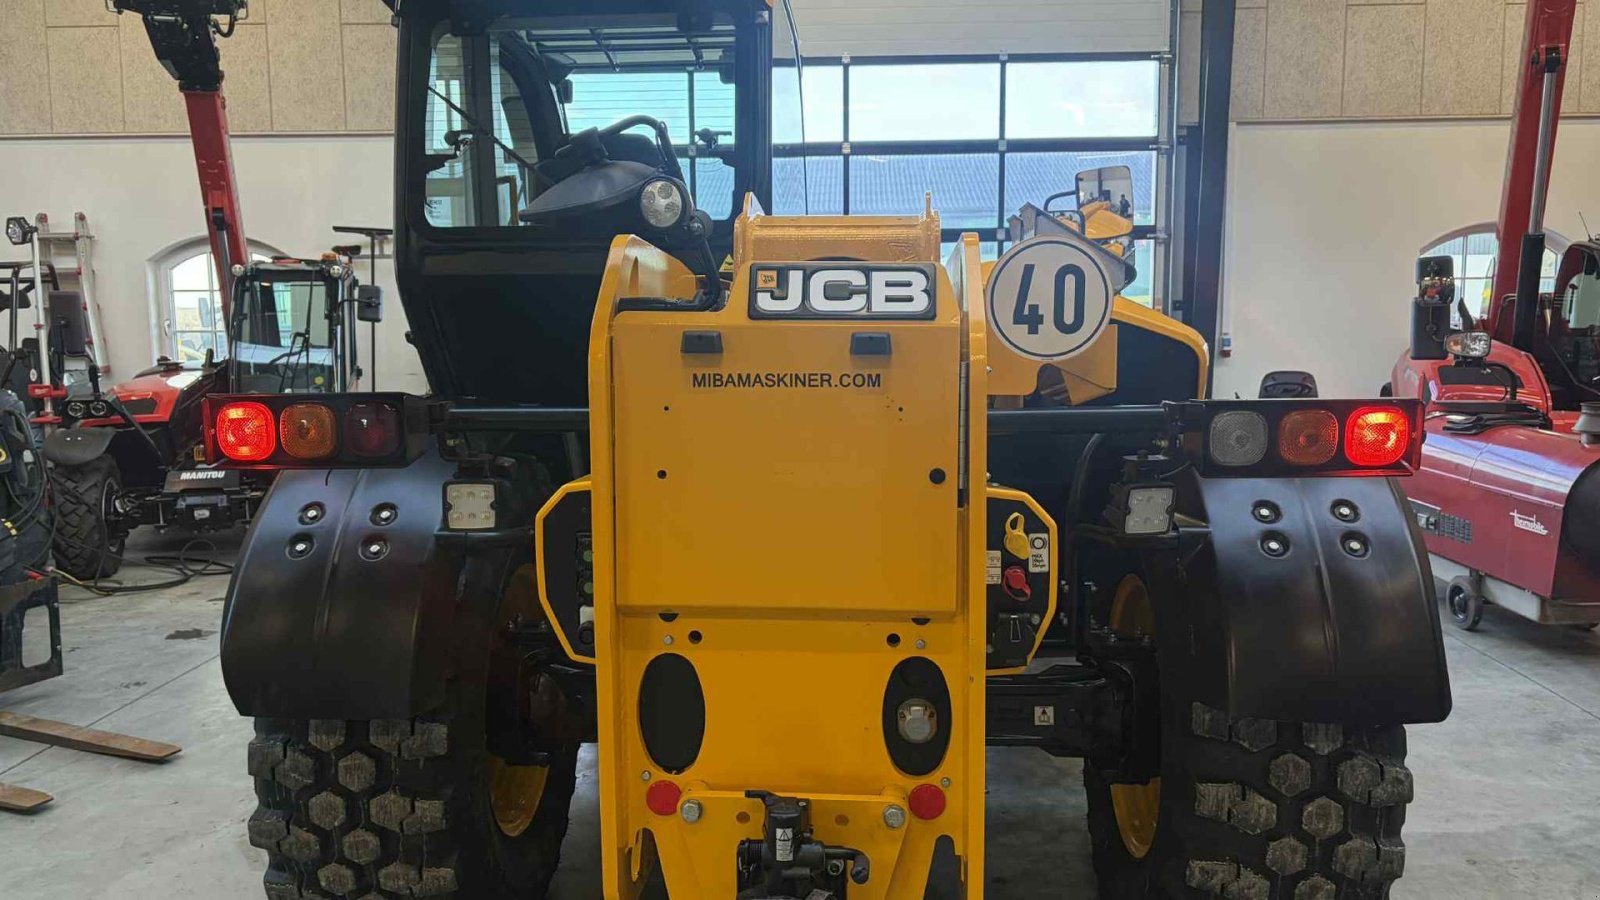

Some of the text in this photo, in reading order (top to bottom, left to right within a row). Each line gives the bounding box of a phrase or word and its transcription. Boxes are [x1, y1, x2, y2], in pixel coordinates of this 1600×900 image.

[756, 269, 929, 313] JCB
[1012, 263, 1086, 335] 40
[692, 373, 881, 388] MIBAMASKINER.COM
[180, 470, 226, 480] MANITOU
